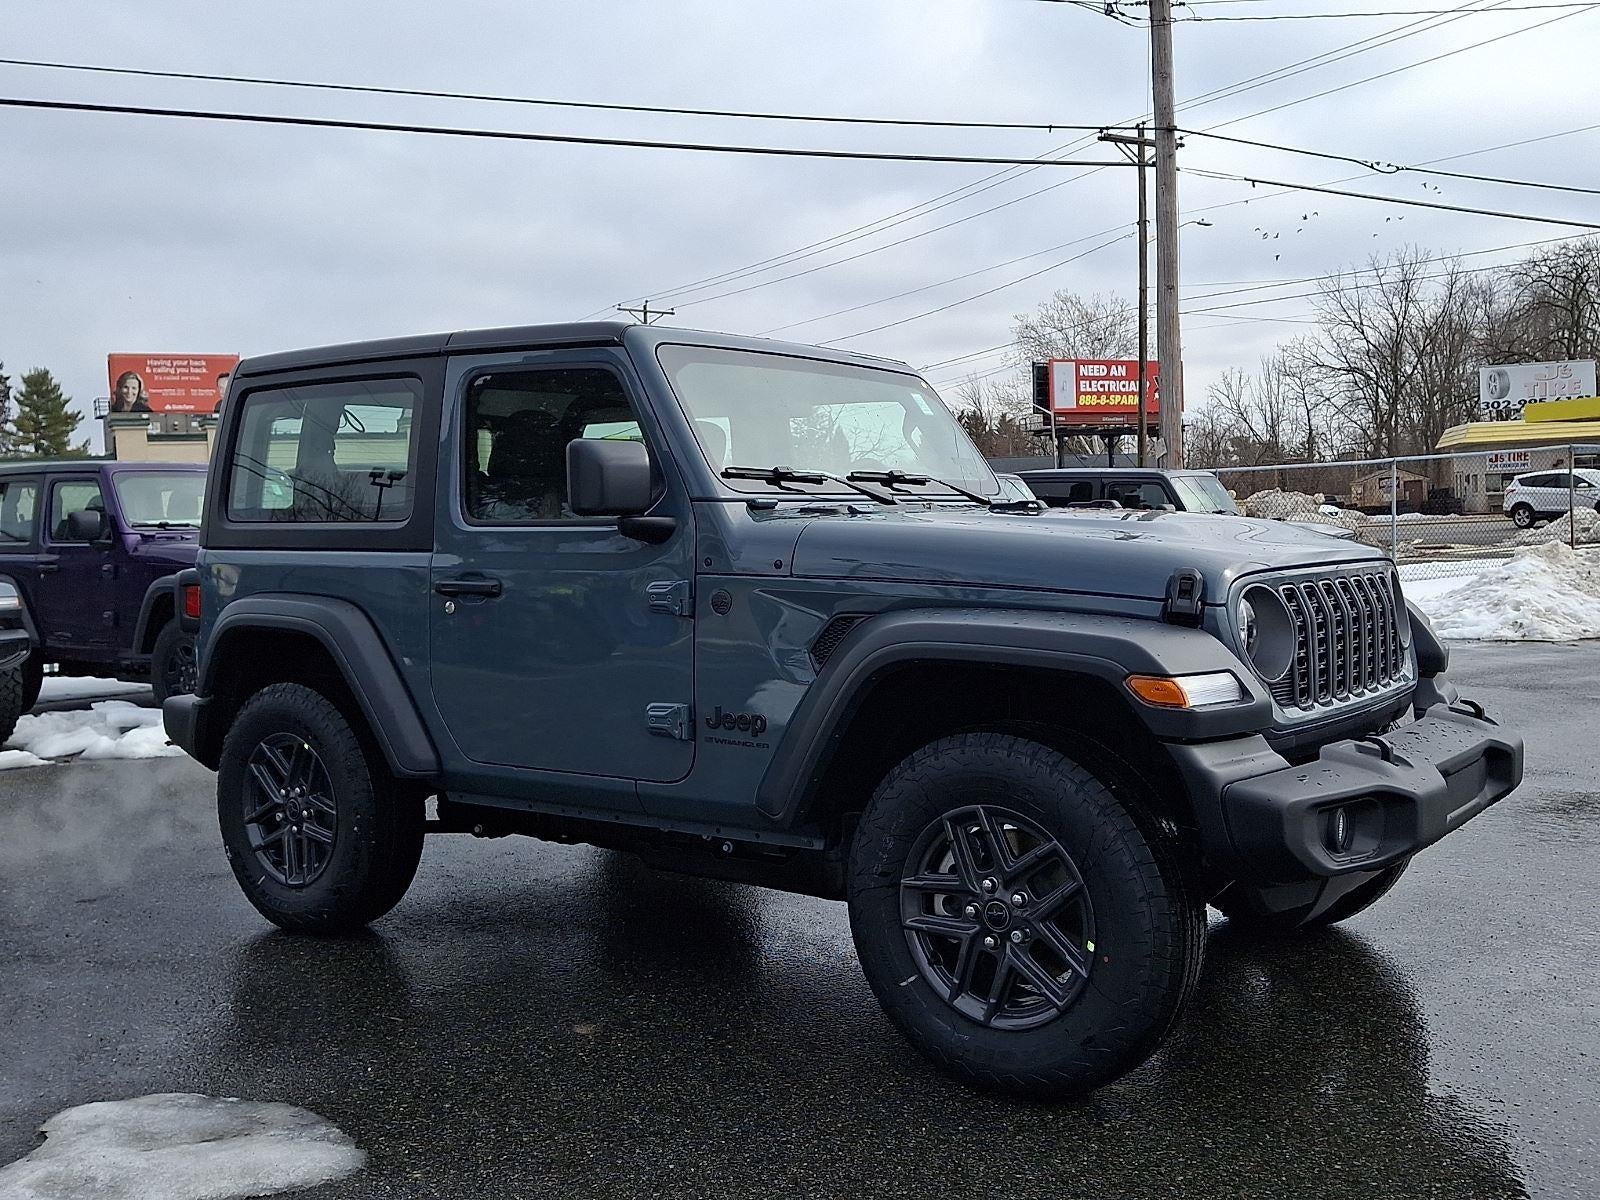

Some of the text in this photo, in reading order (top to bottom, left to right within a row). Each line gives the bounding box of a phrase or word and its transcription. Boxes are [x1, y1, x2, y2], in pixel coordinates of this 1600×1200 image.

[147, 359, 171, 367] Having
[1079, 364, 1127, 377] NEED AN
[1079, 380, 1150, 392] ELECTRICIA?
[1524, 379, 1582, 398] TIRE
[1078, 394, 1140, 406] 888-8-SPARK
[1508, 452, 1529, 462] TIRE
[705, 705, 767, 737] Jeep
[714, 737, 770, 749] WRANGLER
